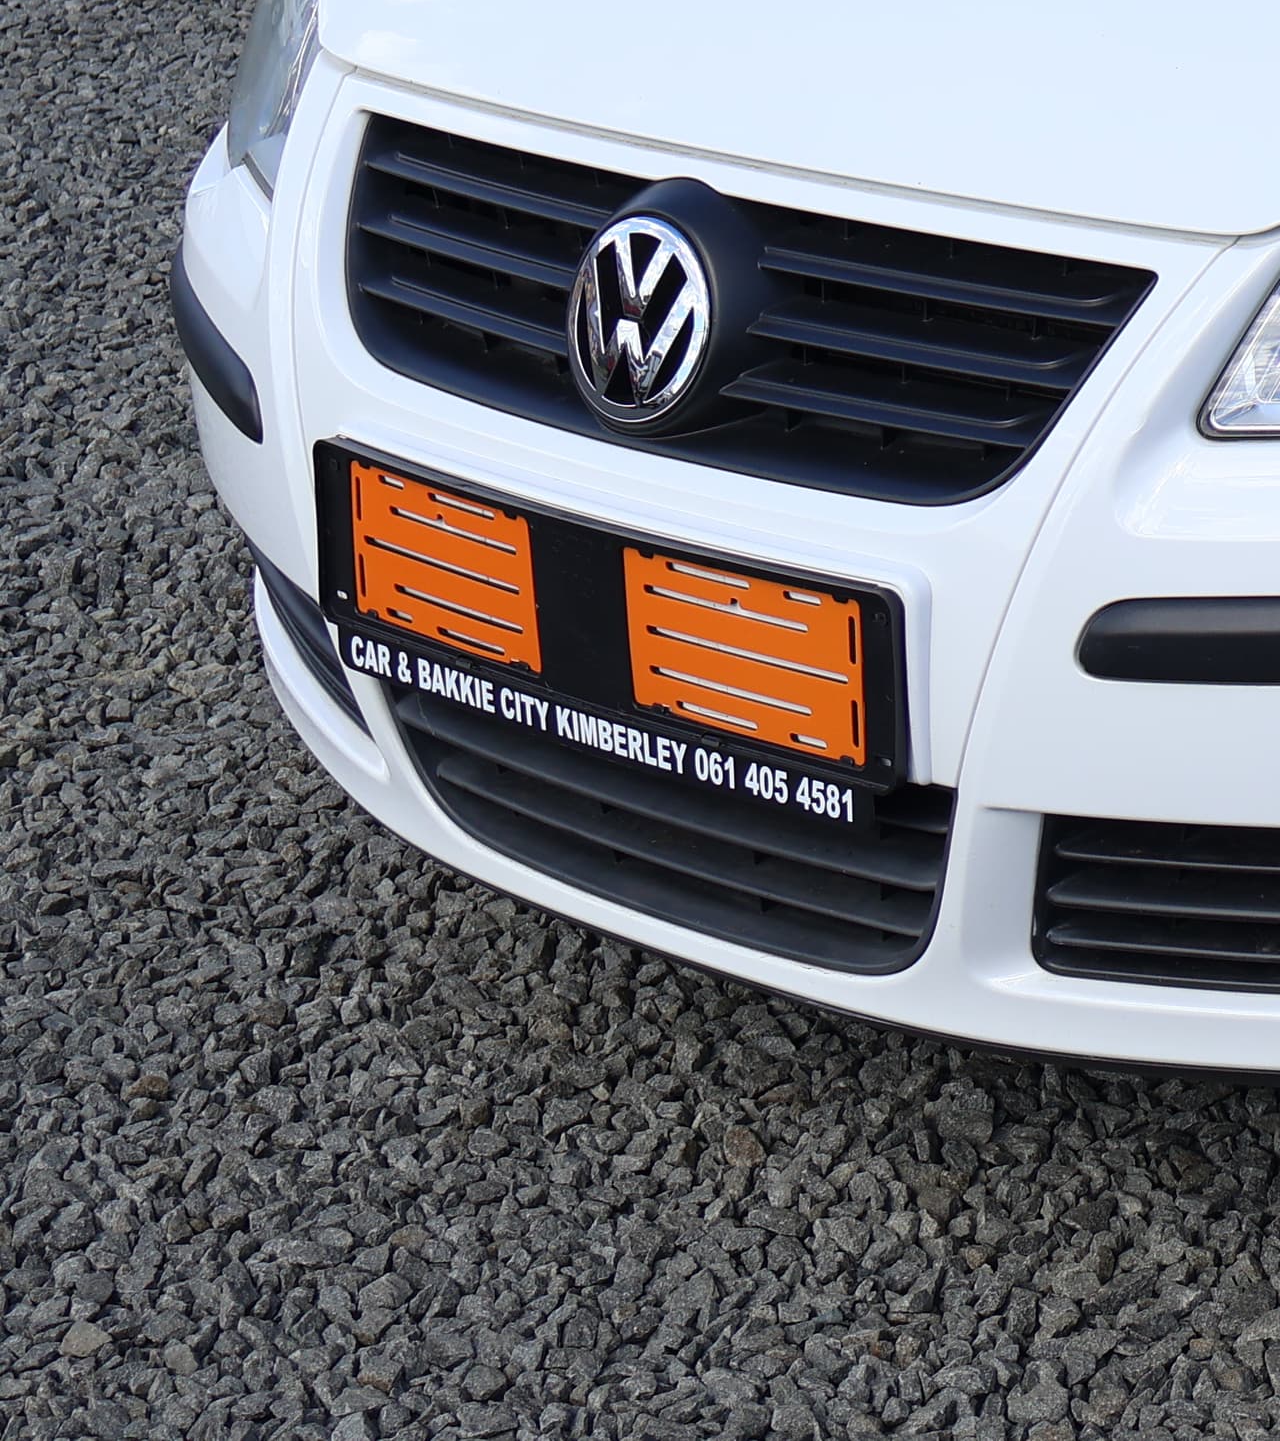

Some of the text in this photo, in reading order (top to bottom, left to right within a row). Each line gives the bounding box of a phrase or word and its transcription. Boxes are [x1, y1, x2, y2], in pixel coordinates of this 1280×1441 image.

[350, 634, 854, 823] CAR & BAKKIE CITY KIMBERLEY 061 405 4581
